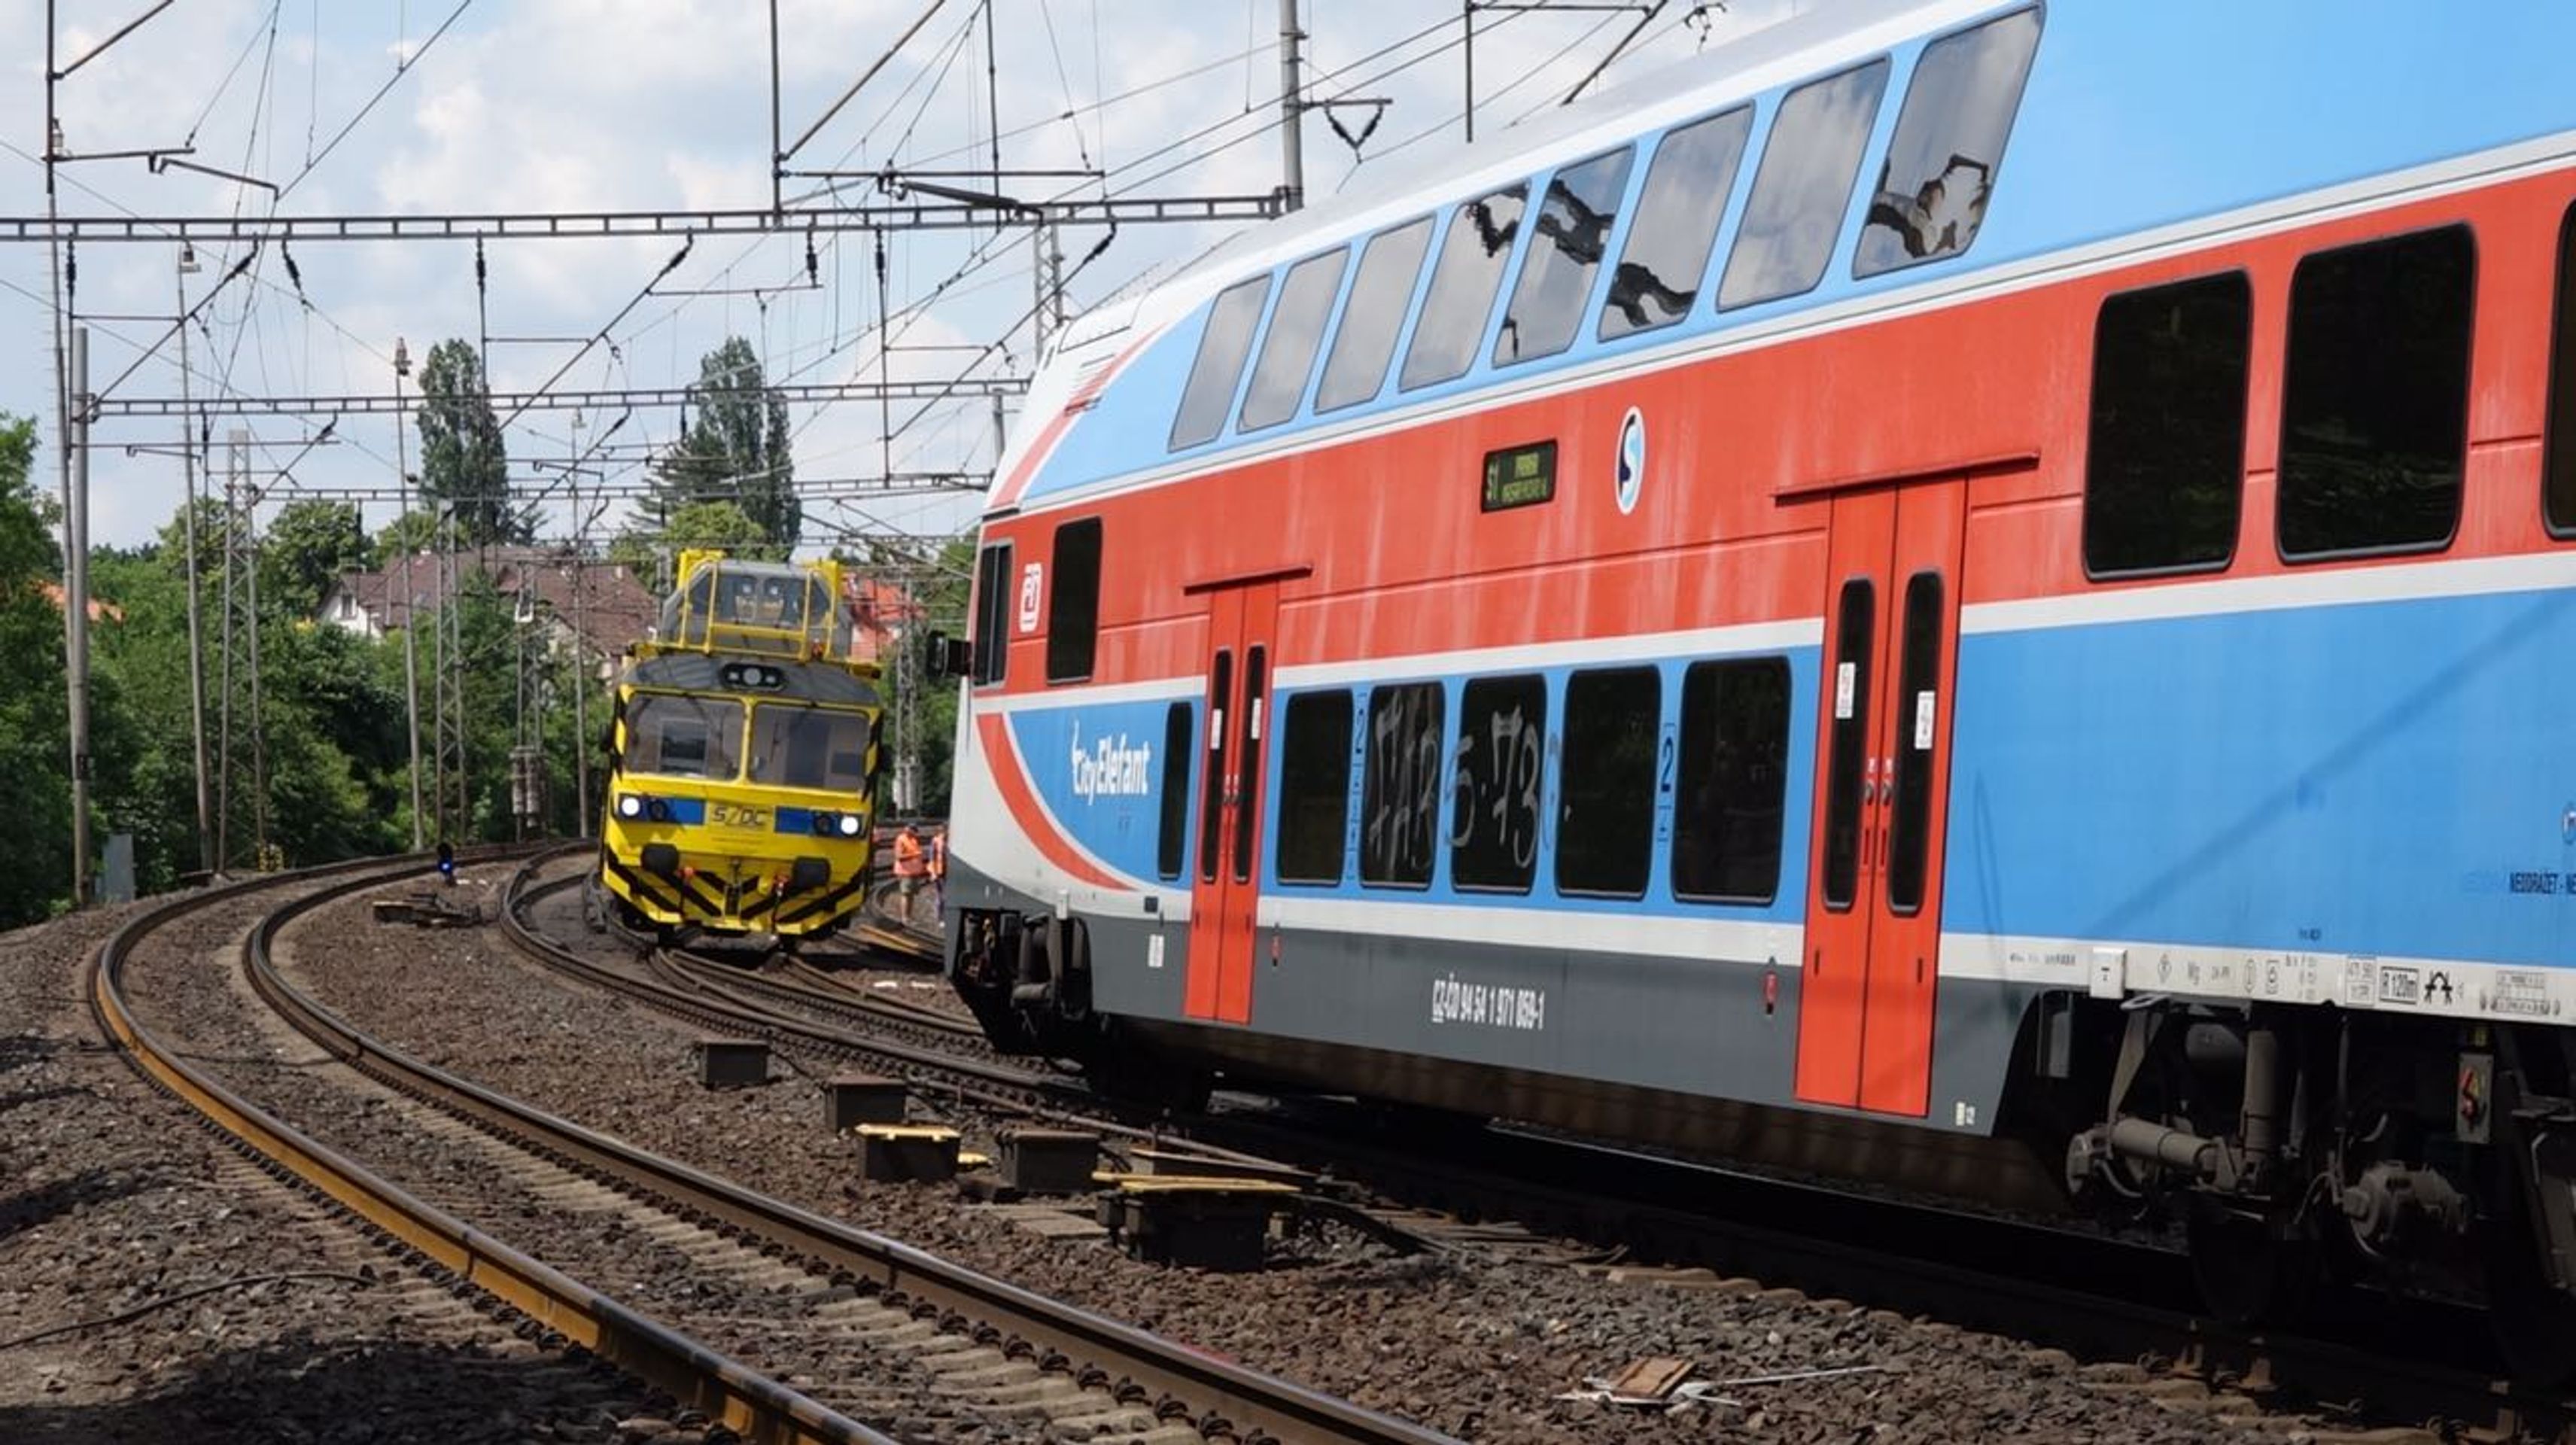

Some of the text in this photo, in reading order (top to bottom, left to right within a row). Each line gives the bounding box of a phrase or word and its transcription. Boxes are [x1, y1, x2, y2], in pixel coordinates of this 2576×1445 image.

[1661, 735, 1674, 792] 2
[1460, 982, 1474, 1022] 94
[1474, 984, 1487, 1024] 54
[1489, 986, 1496, 1024] 1
[1496, 987, 1515, 1027] 971
